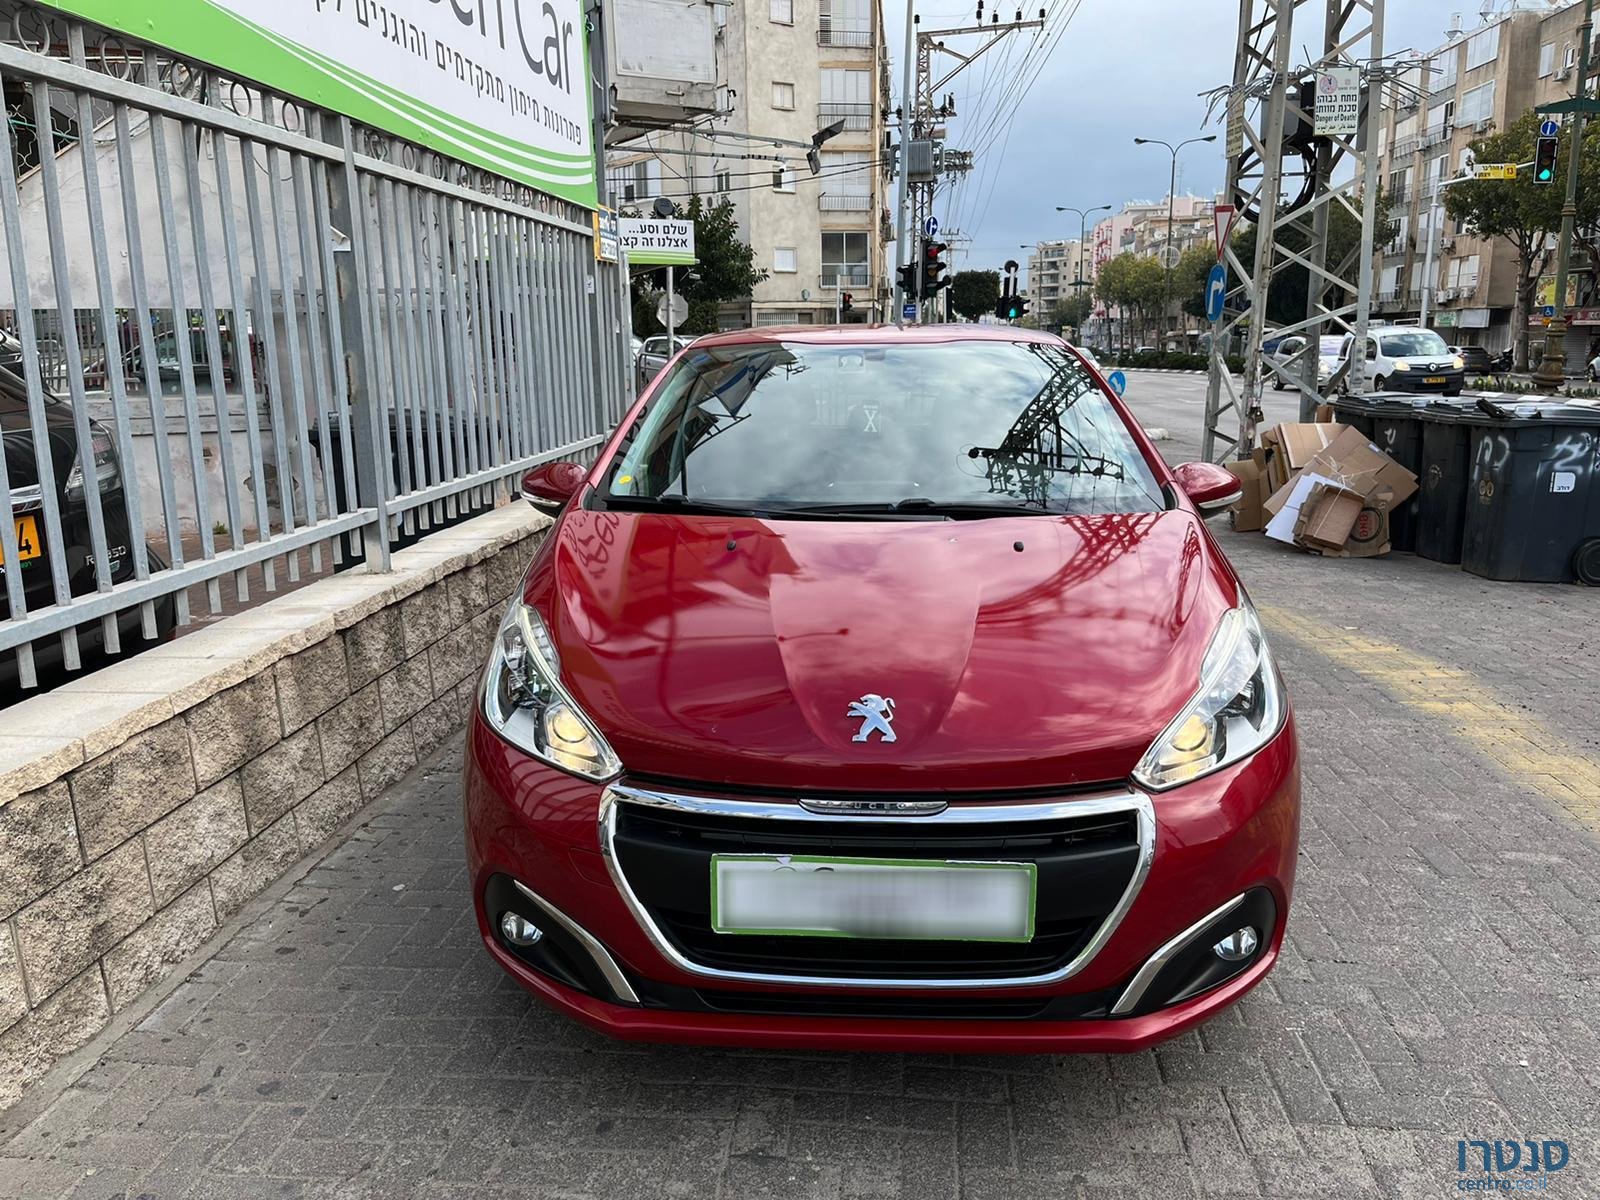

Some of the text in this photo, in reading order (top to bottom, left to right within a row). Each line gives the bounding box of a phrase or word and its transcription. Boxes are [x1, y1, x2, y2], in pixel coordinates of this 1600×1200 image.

[355, 0, 429, 61] והוגנים
[434, 39, 505, 104] מתקדמים
[508, 84, 541, 123] מימון
[1340, 94, 1357, 102] מתח
[543, 105, 582, 147] פתרונות
[1506, 167, 1514, 175] 13
[629, 224, 688, 235] שלם וסע...
[641, 237, 655, 247] זה
[658, 235, 688, 248] אצלנו
